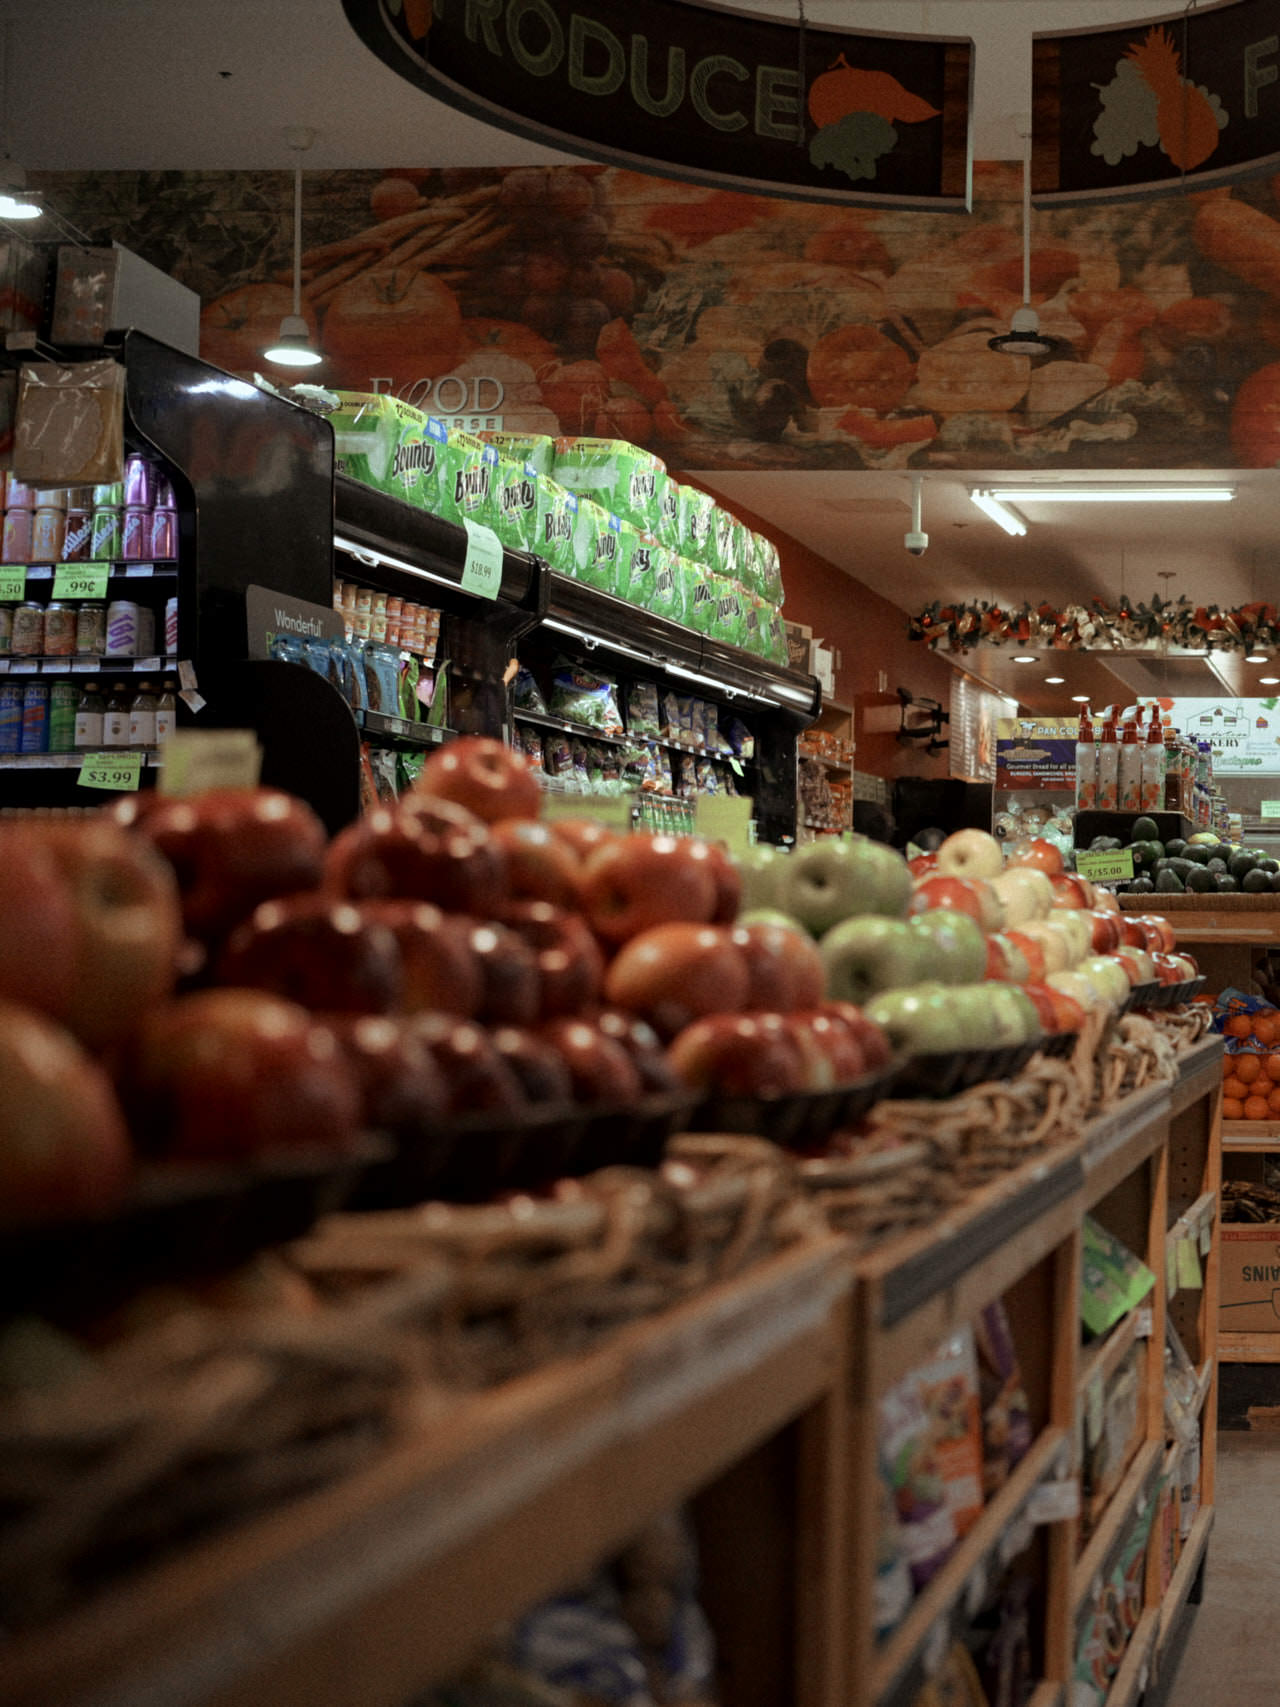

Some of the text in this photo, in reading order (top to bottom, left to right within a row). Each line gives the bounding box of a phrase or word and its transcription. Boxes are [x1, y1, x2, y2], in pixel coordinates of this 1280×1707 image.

[432, 0, 801, 141] RODUCE
[438, 418, 497, 430] ERSE
[392, 440, 435, 478] Bounty
[500, 480, 535, 515] ounty
[274, 607, 323, 638] Wonderful
[1037, 725, 1057, 736] PAN
[87, 770, 132, 784] $3.99
